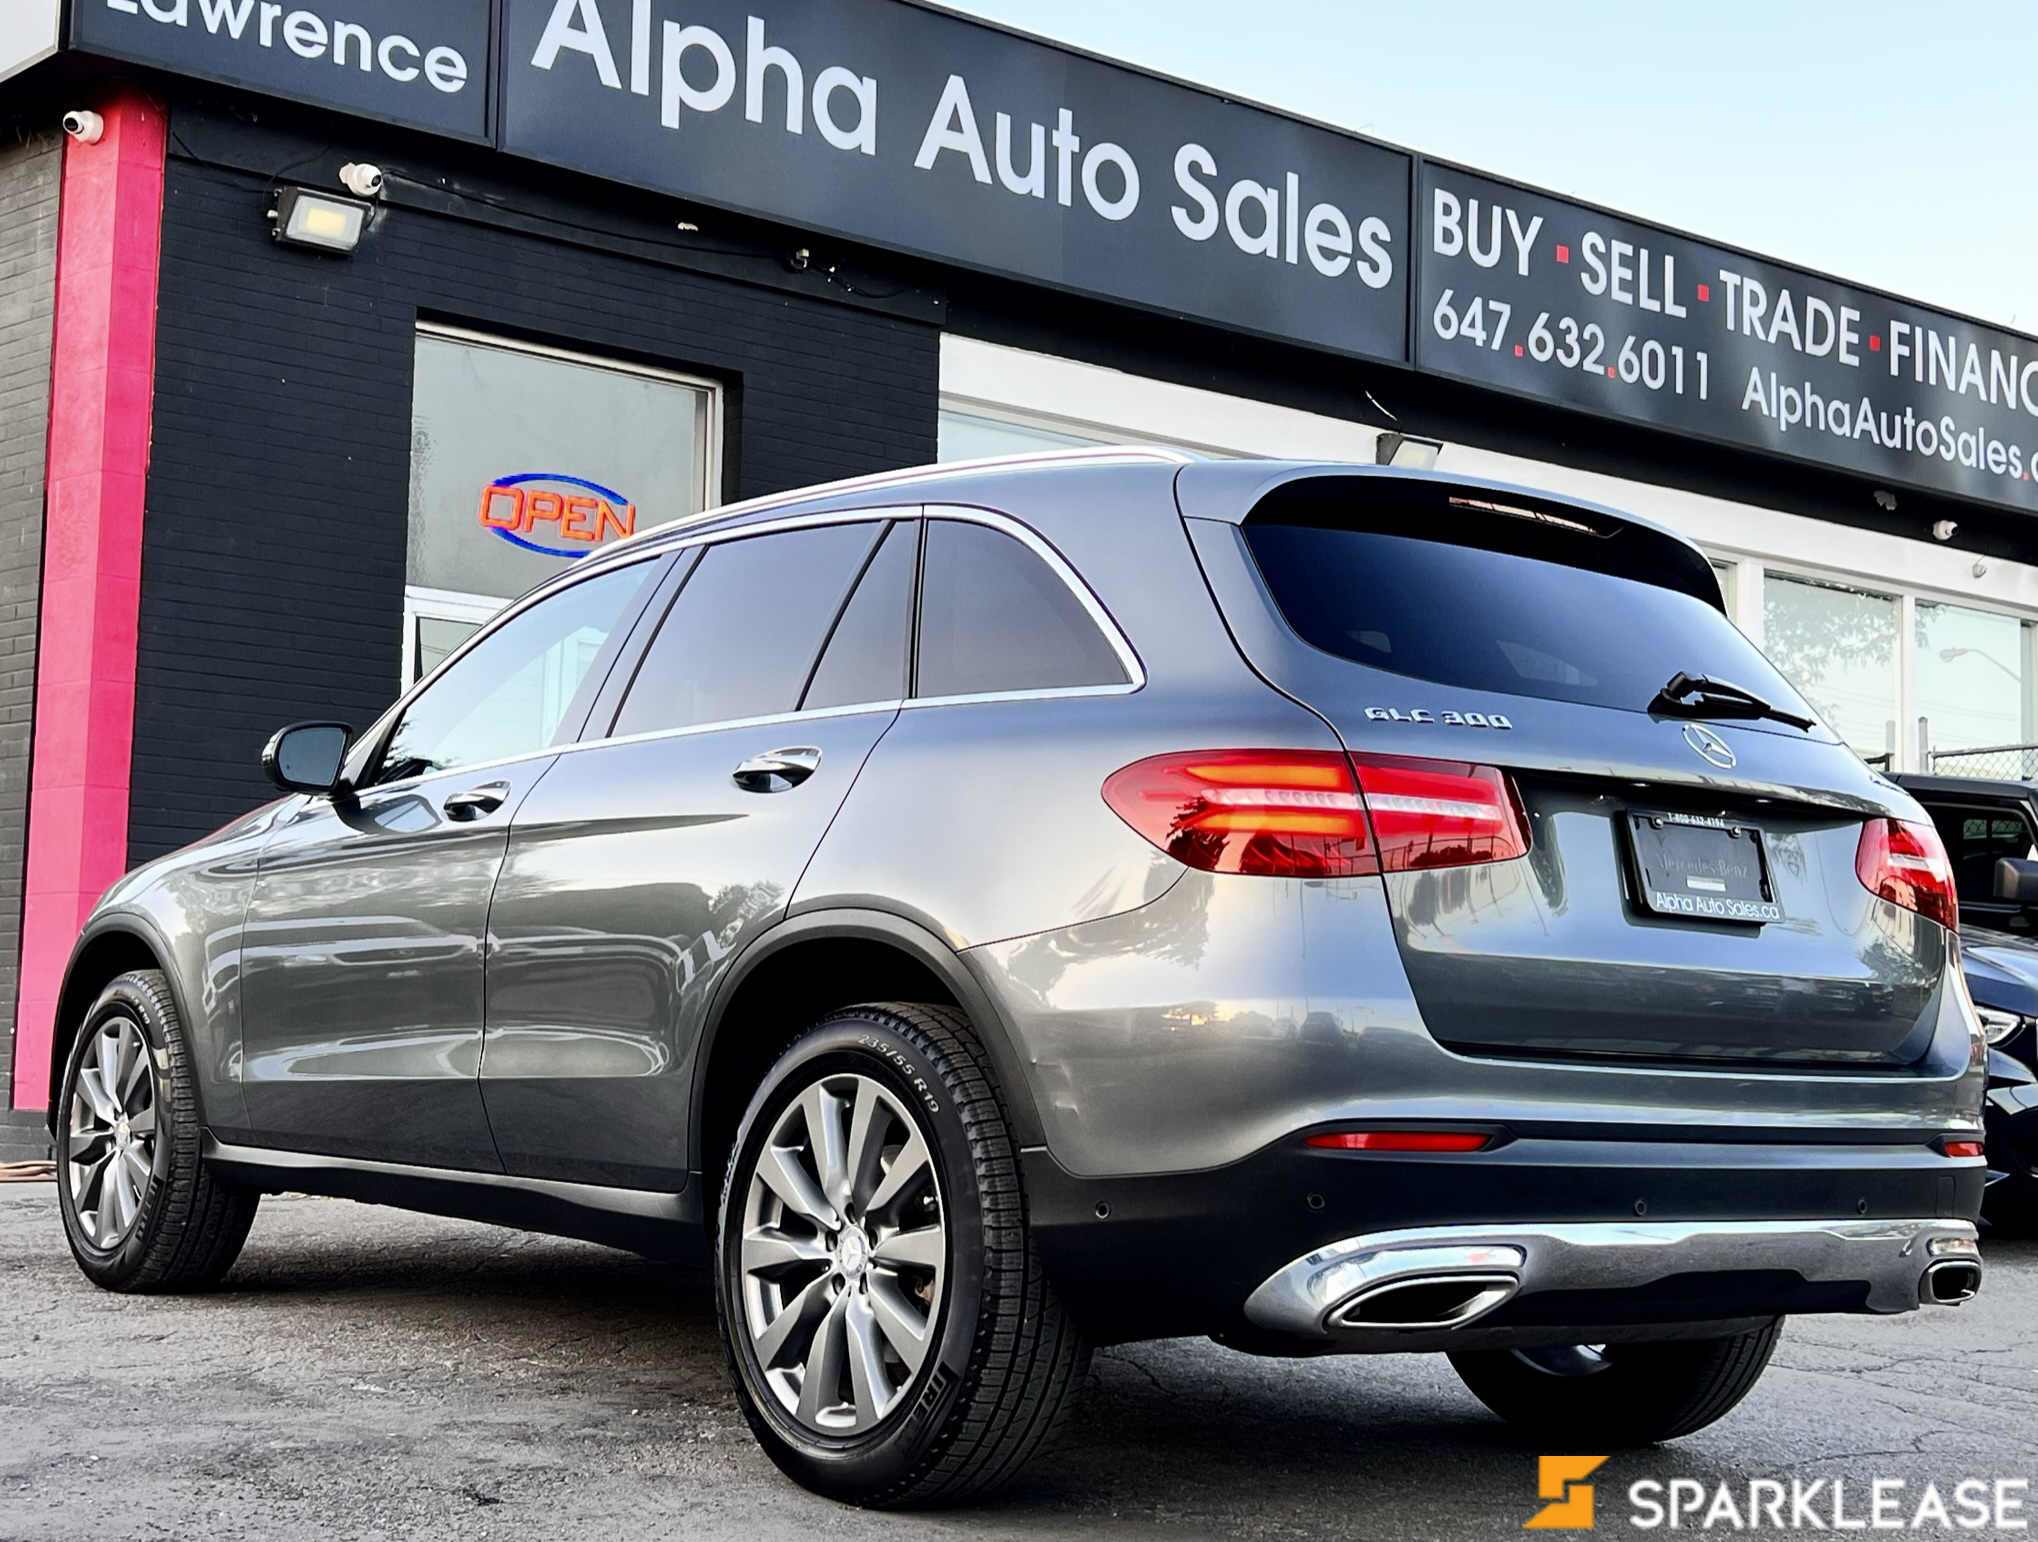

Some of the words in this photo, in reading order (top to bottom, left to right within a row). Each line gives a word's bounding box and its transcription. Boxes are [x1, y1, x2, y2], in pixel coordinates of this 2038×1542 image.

[107, 0, 468, 93] awrence
[530, 0, 877, 156] Alpha
[913, 75, 1140, 221] Auto
[1171, 143, 1393, 289] Sales
[1433, 188, 1543, 276] BUY
[1581, 232, 1687, 318] SELL
[1719, 269, 1860, 367] TRADE
[1433, 289, 1709, 400] 647.632.6011
[479, 485, 636, 541] OPEN
[1364, 707, 1435, 722] GLC
[1441, 710, 1513, 729] 300
[1655, 892, 1693, 912] Alpha
[1696, 897, 1724, 915] Auto
[1728, 898, 1780, 919] Sales.ca
[857, 1034, 916, 1075] 235/55
[914, 1077, 939, 1113] R19
